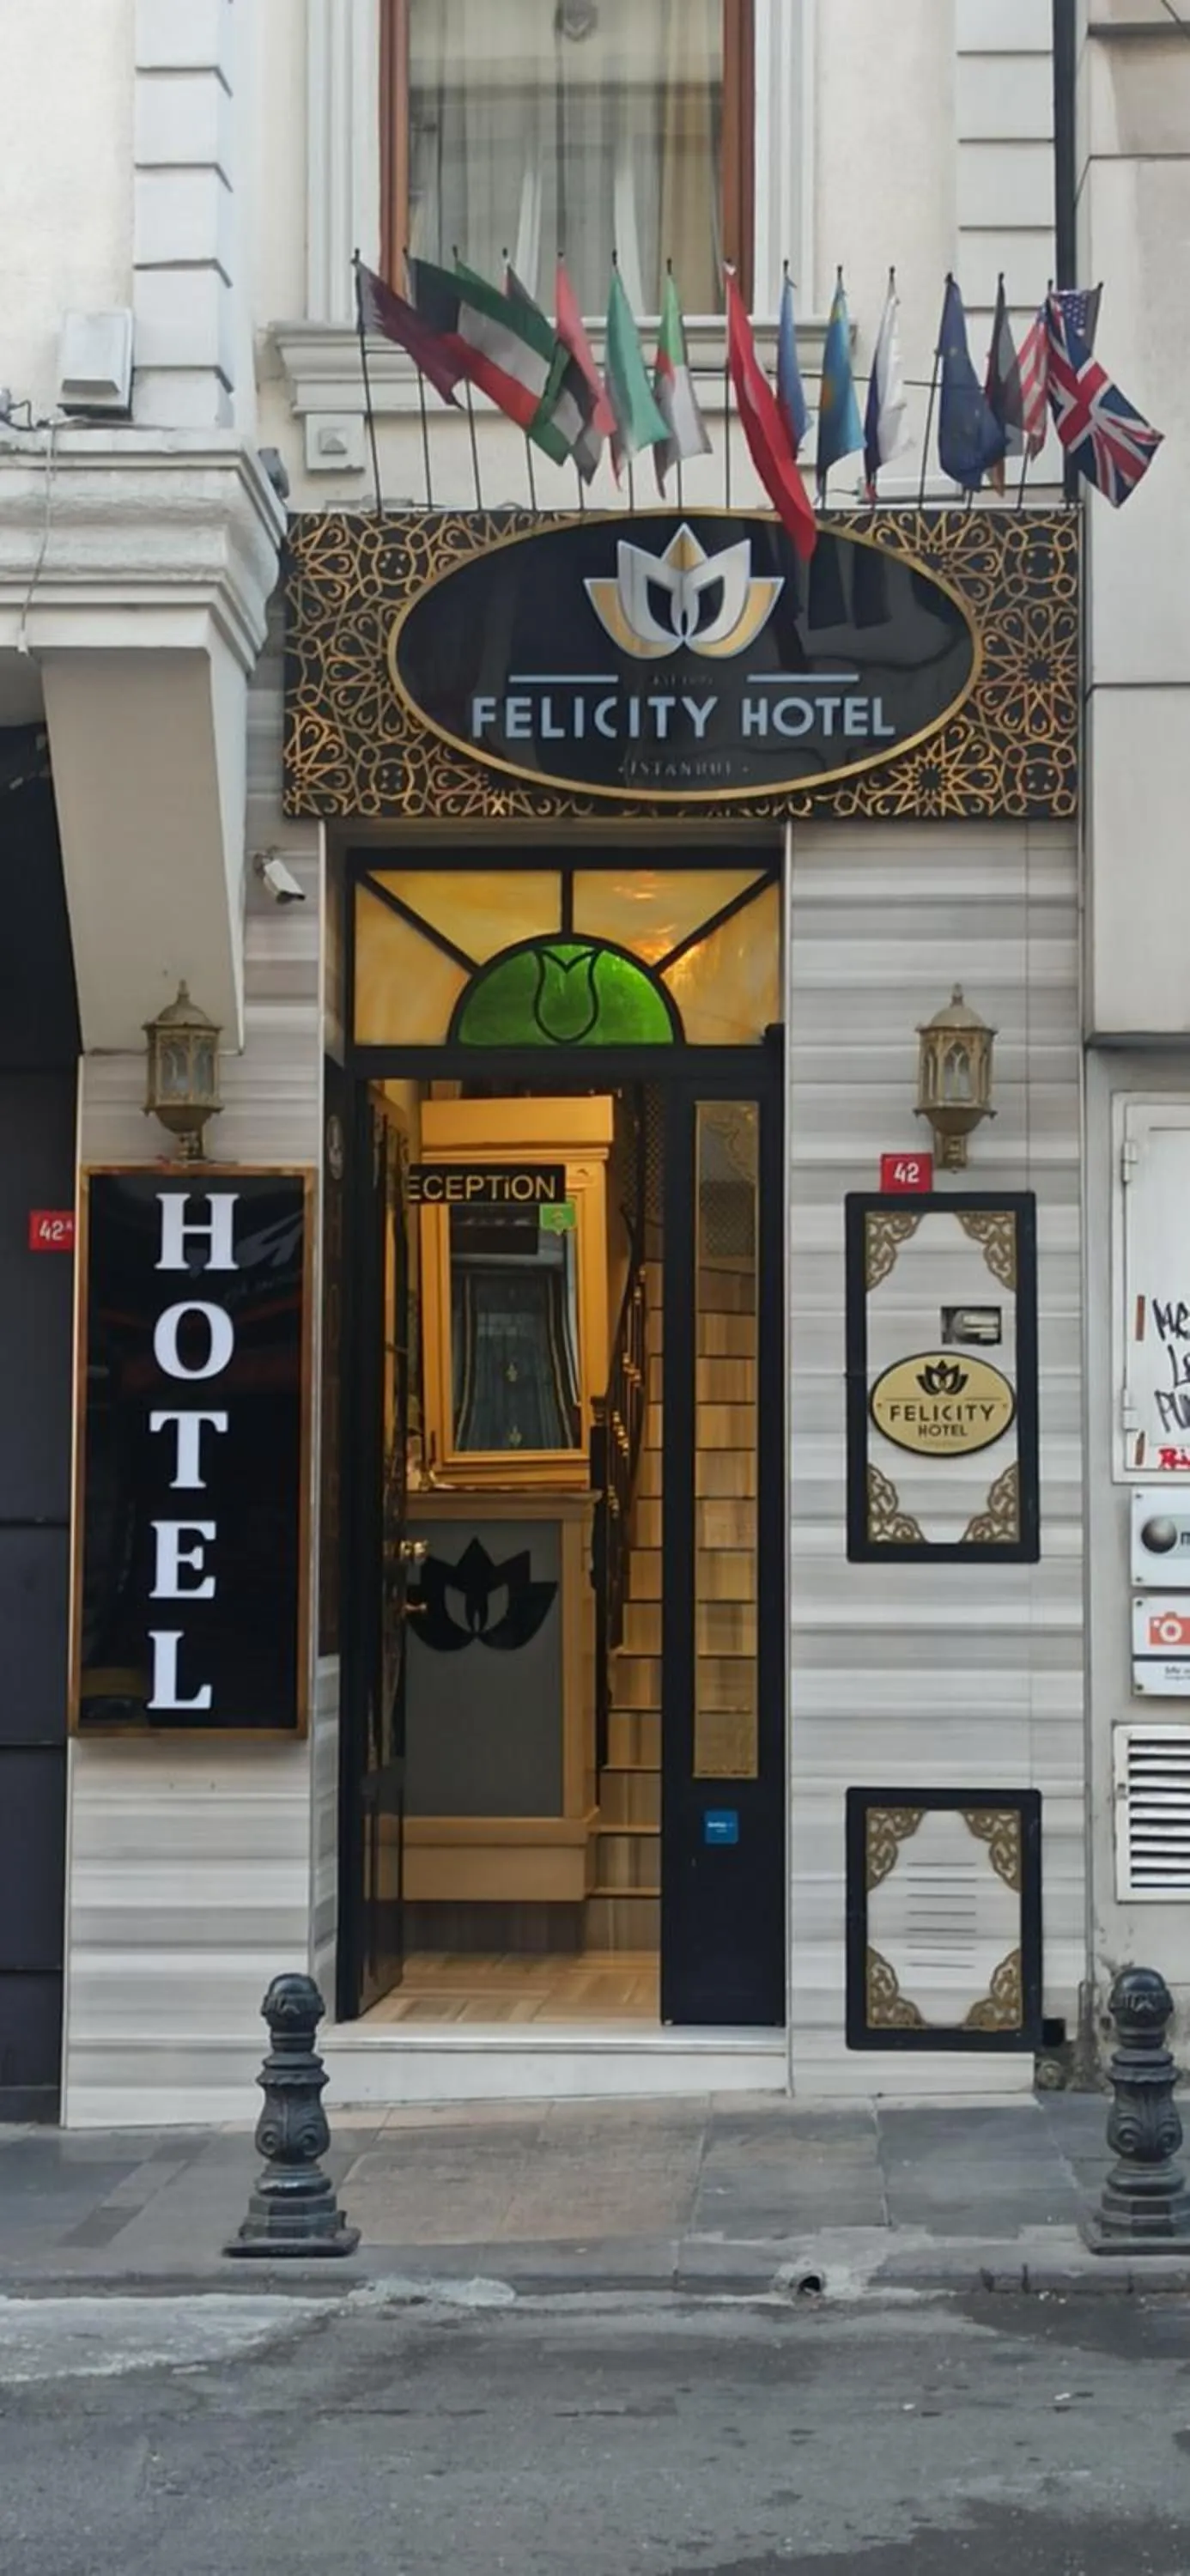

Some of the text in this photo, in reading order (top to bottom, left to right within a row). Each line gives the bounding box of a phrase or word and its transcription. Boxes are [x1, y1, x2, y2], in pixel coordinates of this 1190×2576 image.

[472, 696, 896, 738] FELICITY HOTEL
[894, 1162, 920, 1183] 42
[889, 1404, 995, 1422] FELICITY
[918, 1424, 968, 1437] HOTEL
[147, 1192, 240, 1710] HOTEL
